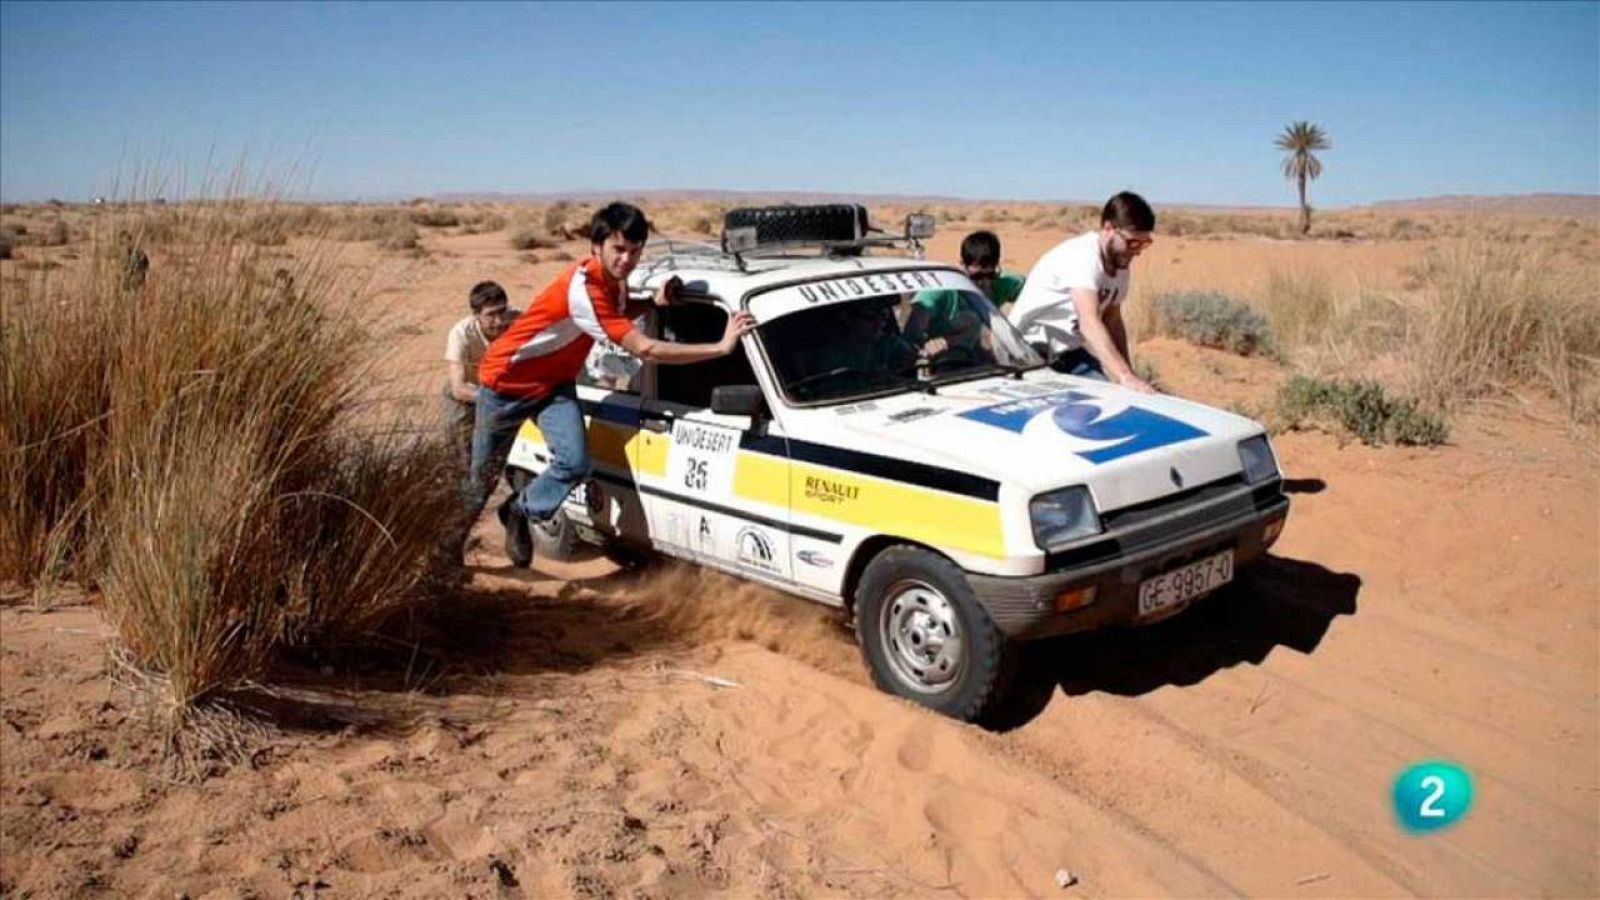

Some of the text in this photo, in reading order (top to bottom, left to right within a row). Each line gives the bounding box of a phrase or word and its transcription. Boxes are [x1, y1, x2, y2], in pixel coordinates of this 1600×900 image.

[798, 271, 943, 303] UNIDESERT
[675, 424, 733, 453] UNIDESERT
[804, 475, 861, 500] RENAULT
